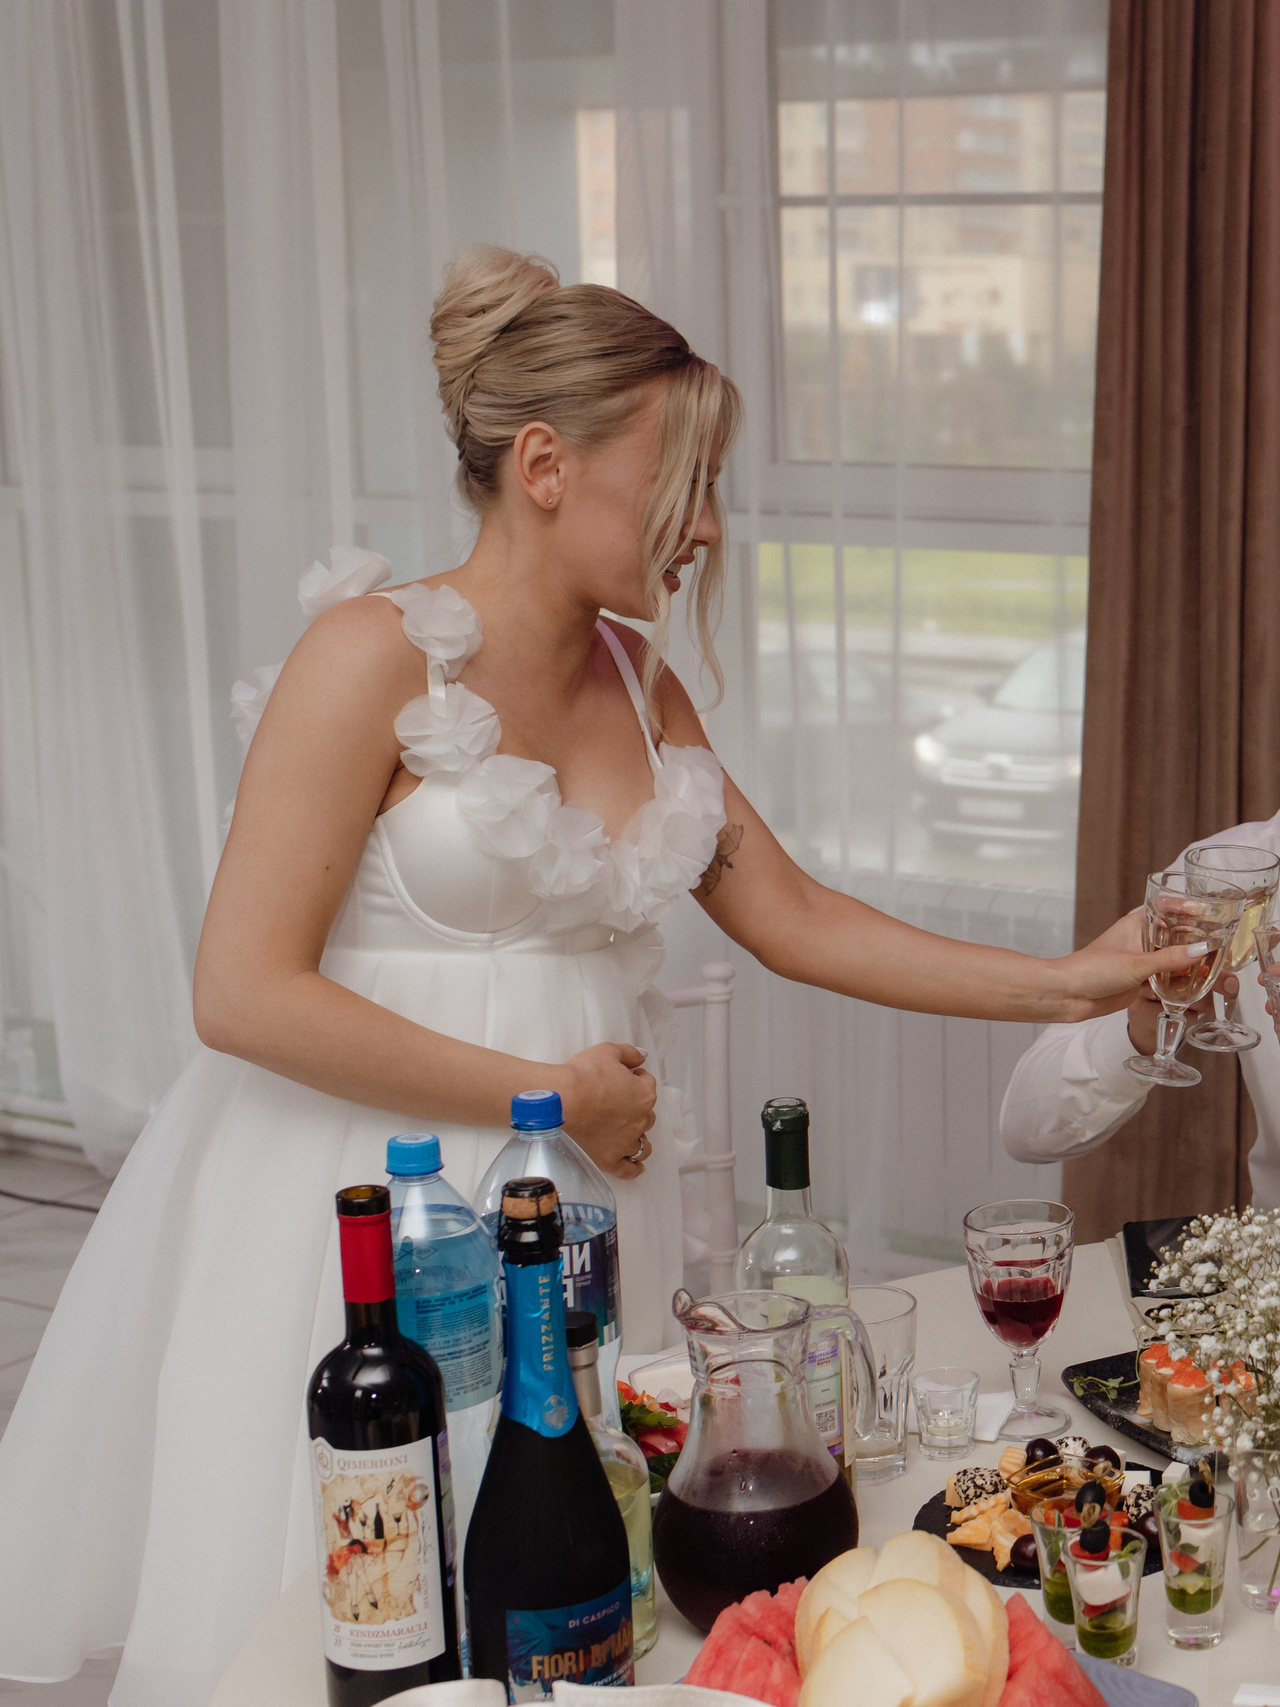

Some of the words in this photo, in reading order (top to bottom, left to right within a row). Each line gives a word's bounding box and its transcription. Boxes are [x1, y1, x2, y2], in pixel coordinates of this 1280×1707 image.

[538, 1274, 555, 1372] FRIZZANTE
[337, 1454, 409, 1471] QIMERIONI
[568, 1619, 580, 1629] DI
[582, 1601, 620, 1625] CASPICO
[349, 1621, 428, 1639] KINDZMARAULI
[531, 1649, 585, 1680] FIORI
